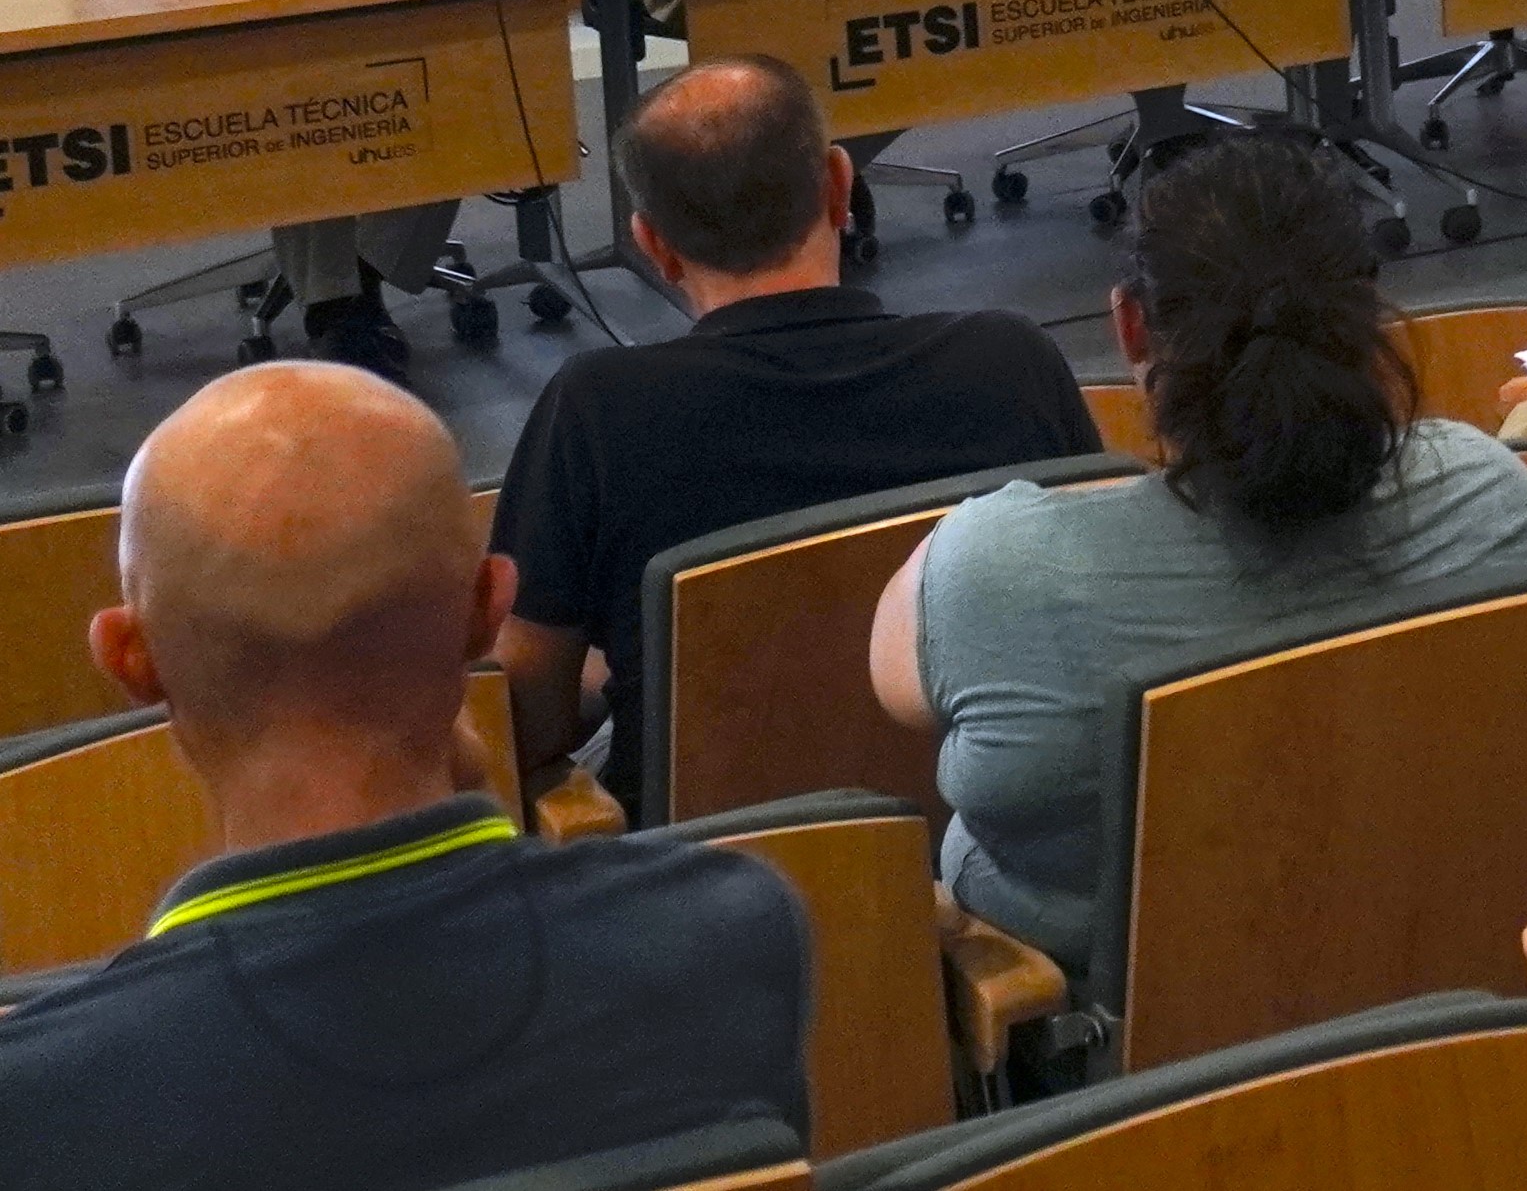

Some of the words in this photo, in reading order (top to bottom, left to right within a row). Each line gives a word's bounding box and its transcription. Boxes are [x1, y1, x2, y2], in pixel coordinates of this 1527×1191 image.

[845, 1, 980, 67] ETSI
[992, 17, 1089, 45] SUPERIOR
[144, 106, 279, 147] ESCUELA
[283, 88, 410, 125] TÉCNICA
[146, 138, 261, 170] SUPERIOR
[289, 114, 412, 151] INGENIERÍA
